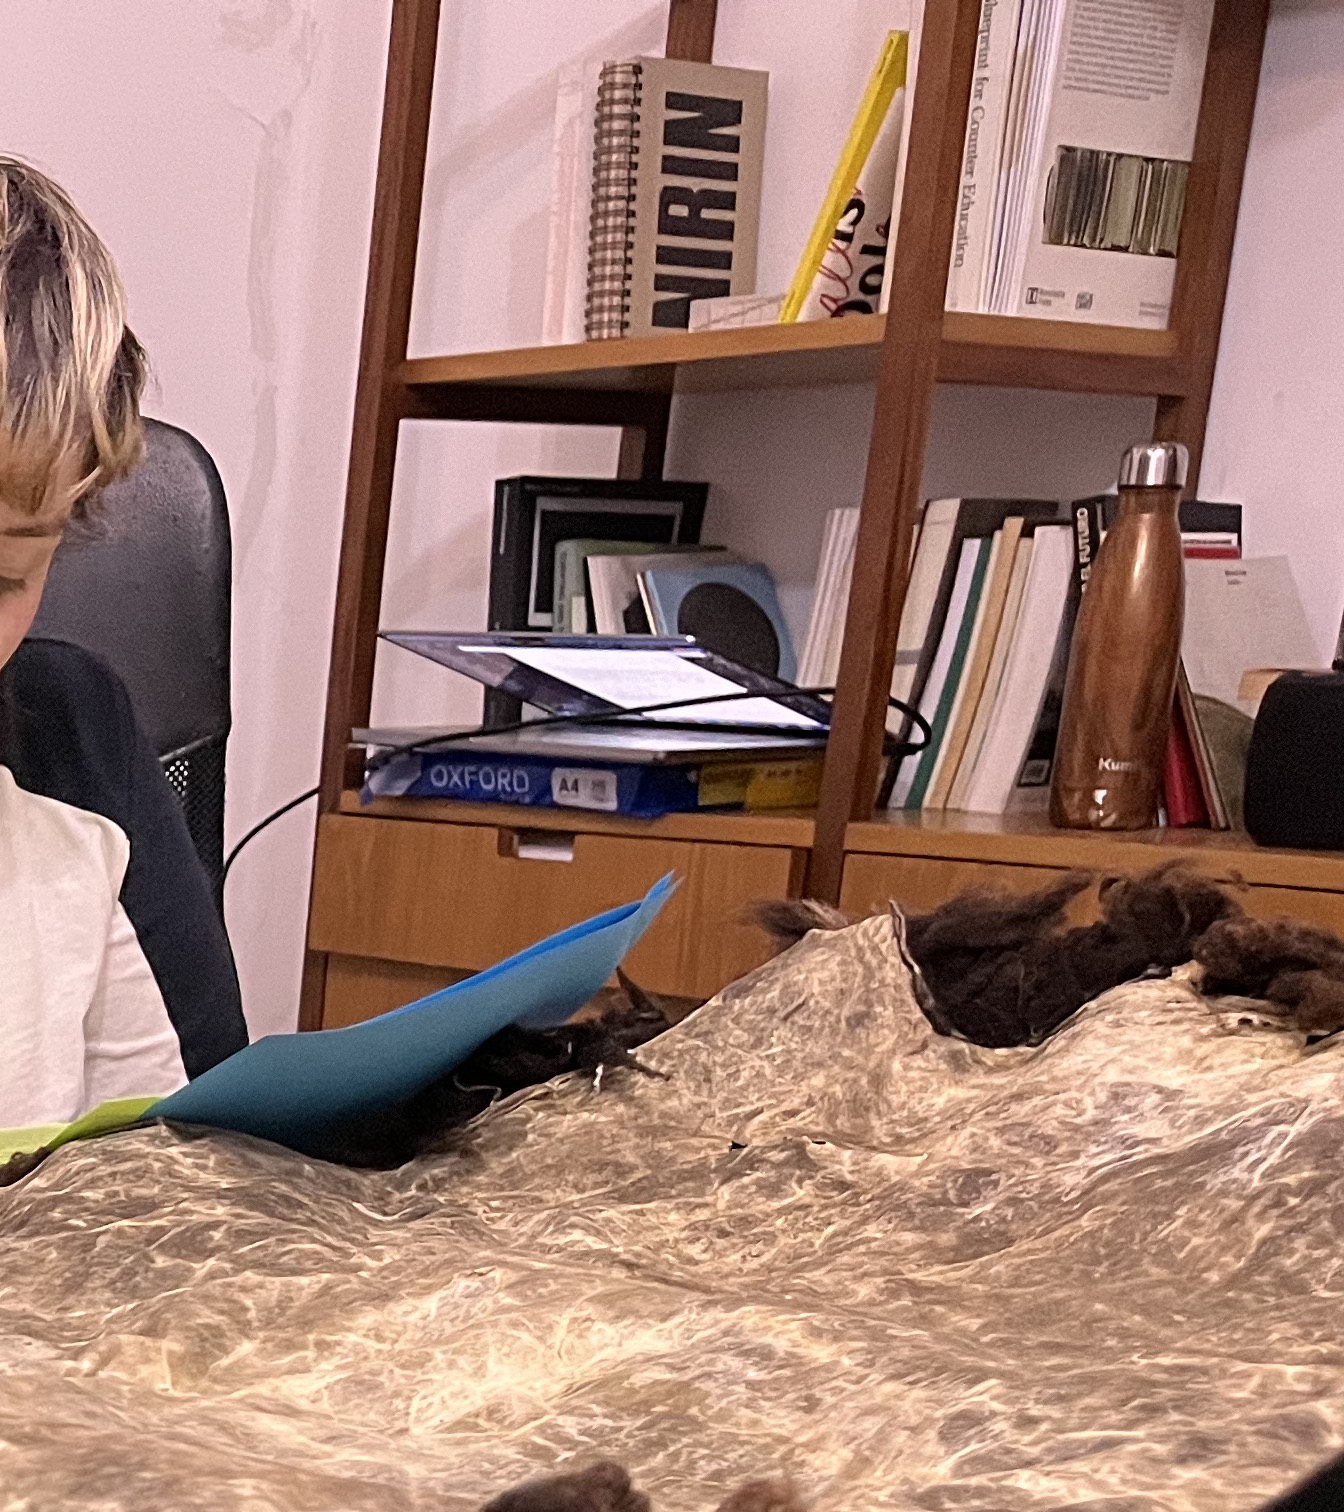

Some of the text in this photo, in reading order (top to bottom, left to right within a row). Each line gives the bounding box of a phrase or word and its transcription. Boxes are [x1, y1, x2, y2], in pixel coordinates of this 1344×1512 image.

[964, 106, 985, 180] Counter
[652, 91, 743, 327] NIRIN
[952, 183, 977, 268] Education
[430, 763, 530, 793] OXFORD
[558, 777, 580, 795] A4
